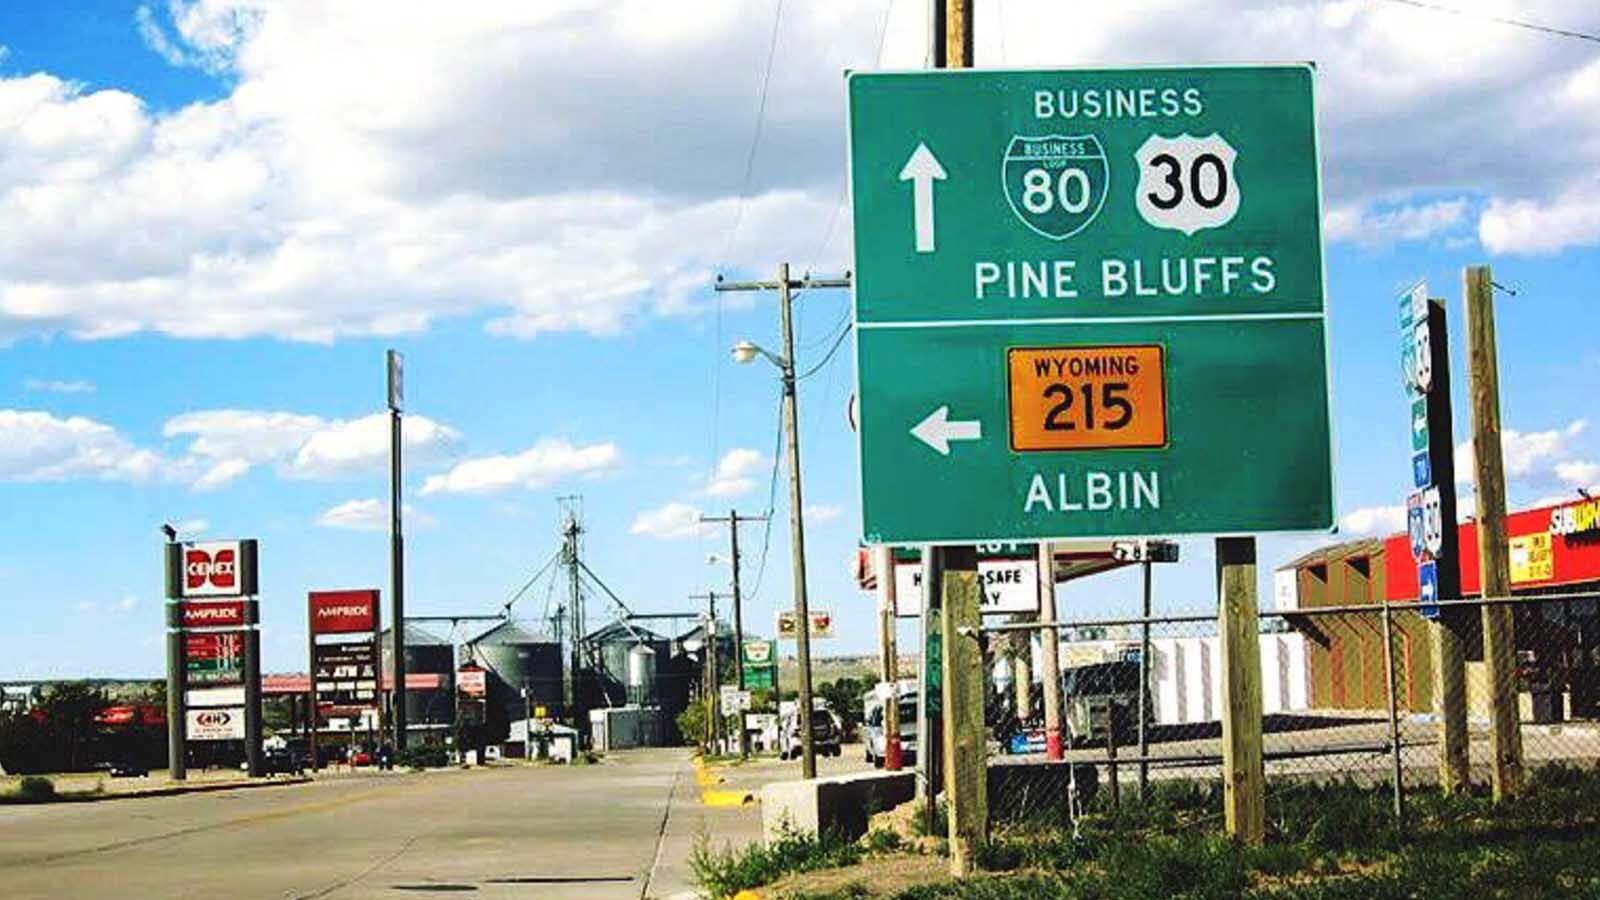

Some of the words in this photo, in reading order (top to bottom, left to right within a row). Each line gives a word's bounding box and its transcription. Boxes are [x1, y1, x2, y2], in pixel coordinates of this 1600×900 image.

[1034, 87, 1203, 119] BUSINESS
[1023, 142, 1086, 156] BUSINESS
[1022, 168, 1091, 214] 80
[1147, 153, 1228, 210] 30
[974, 260, 1078, 299] PINE
[1101, 256, 1276, 296] BLUFFS
[1034, 355, 1140, 377] WYOMING
[1043, 382, 1133, 431] 215
[1023, 471, 1161, 512] ALBIN
